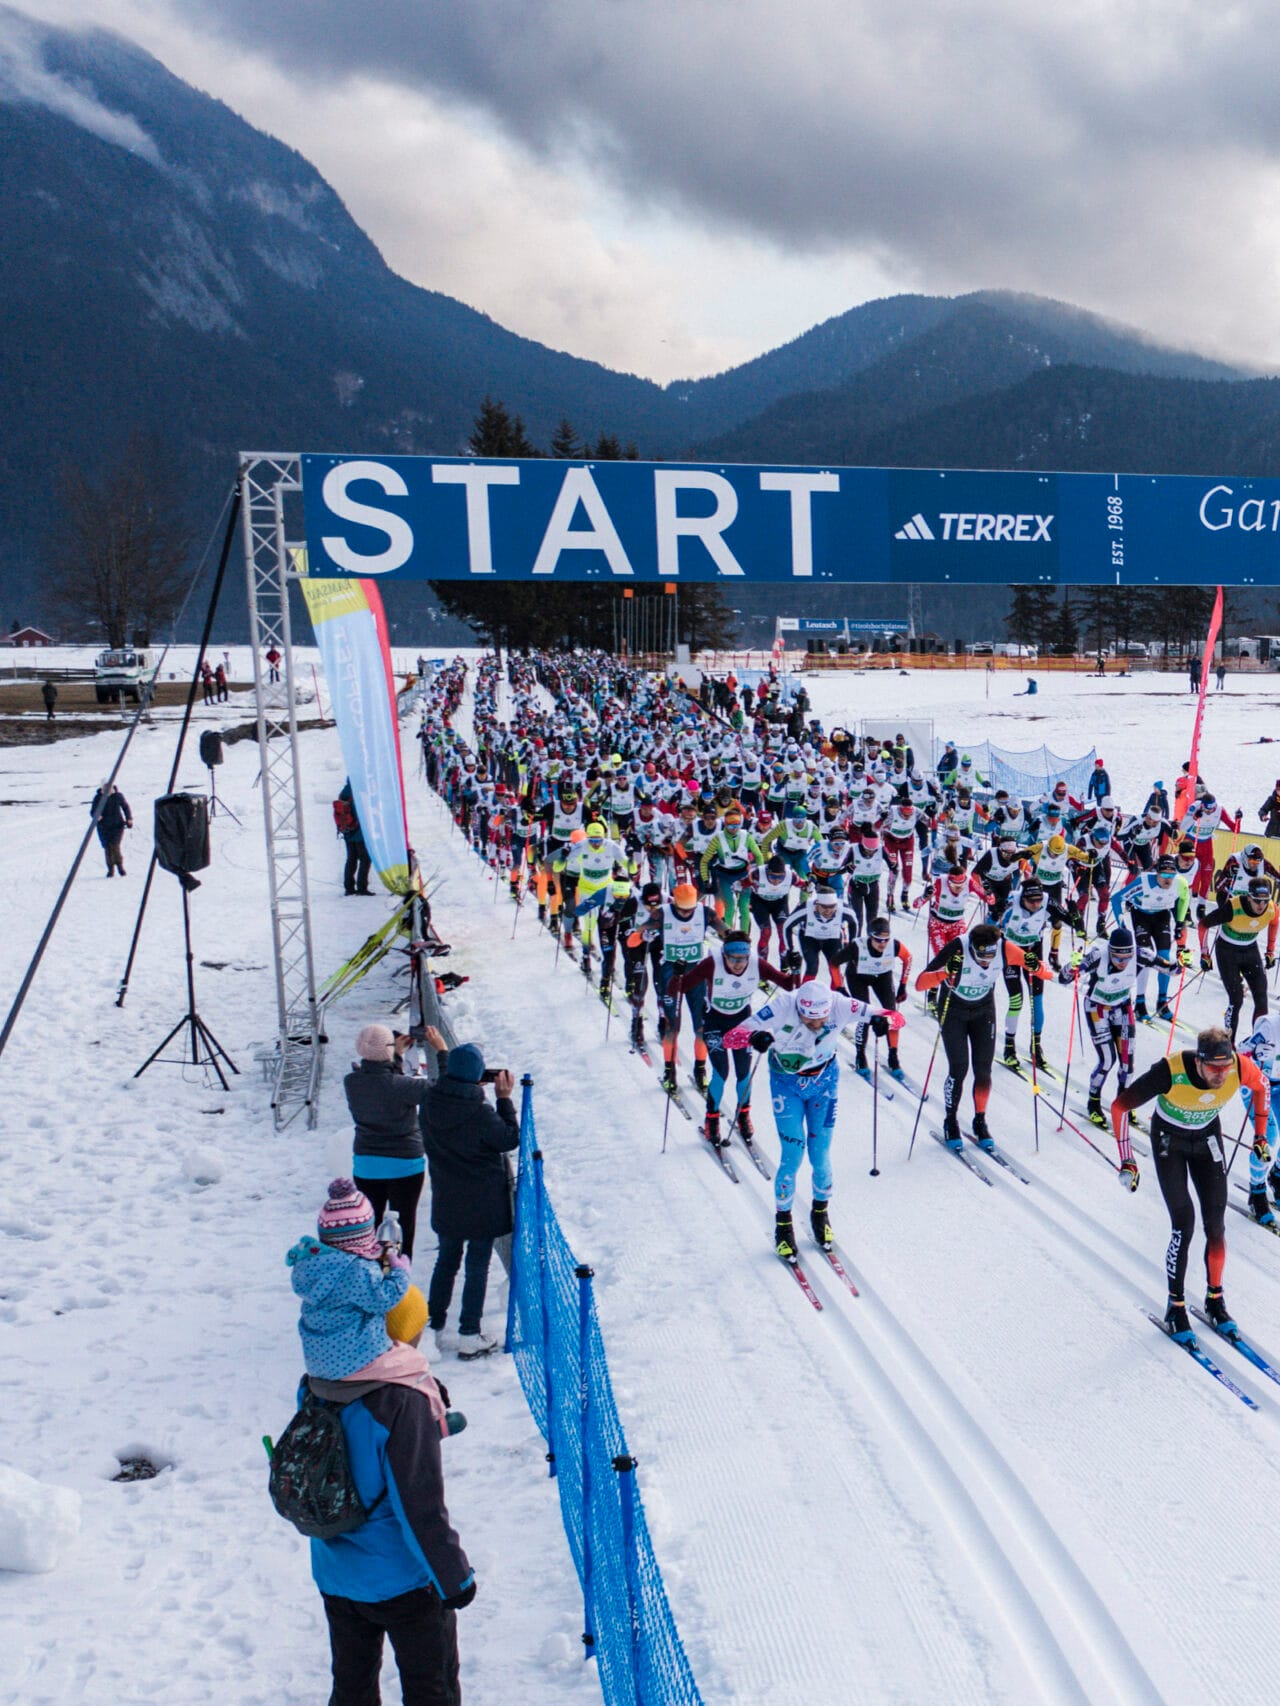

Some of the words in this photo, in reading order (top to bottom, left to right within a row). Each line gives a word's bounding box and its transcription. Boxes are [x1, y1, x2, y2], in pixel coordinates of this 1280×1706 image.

[322, 460, 841, 577] START
[939, 513, 1055, 541] TERREX
[1107, 496, 1124, 531] 1968
[1111, 536, 1124, 566] EST.
[805, 620, 838, 629] Leutasch
[670, 946, 699, 958] 1370
[1165, 1228, 1183, 1281] TERREX
